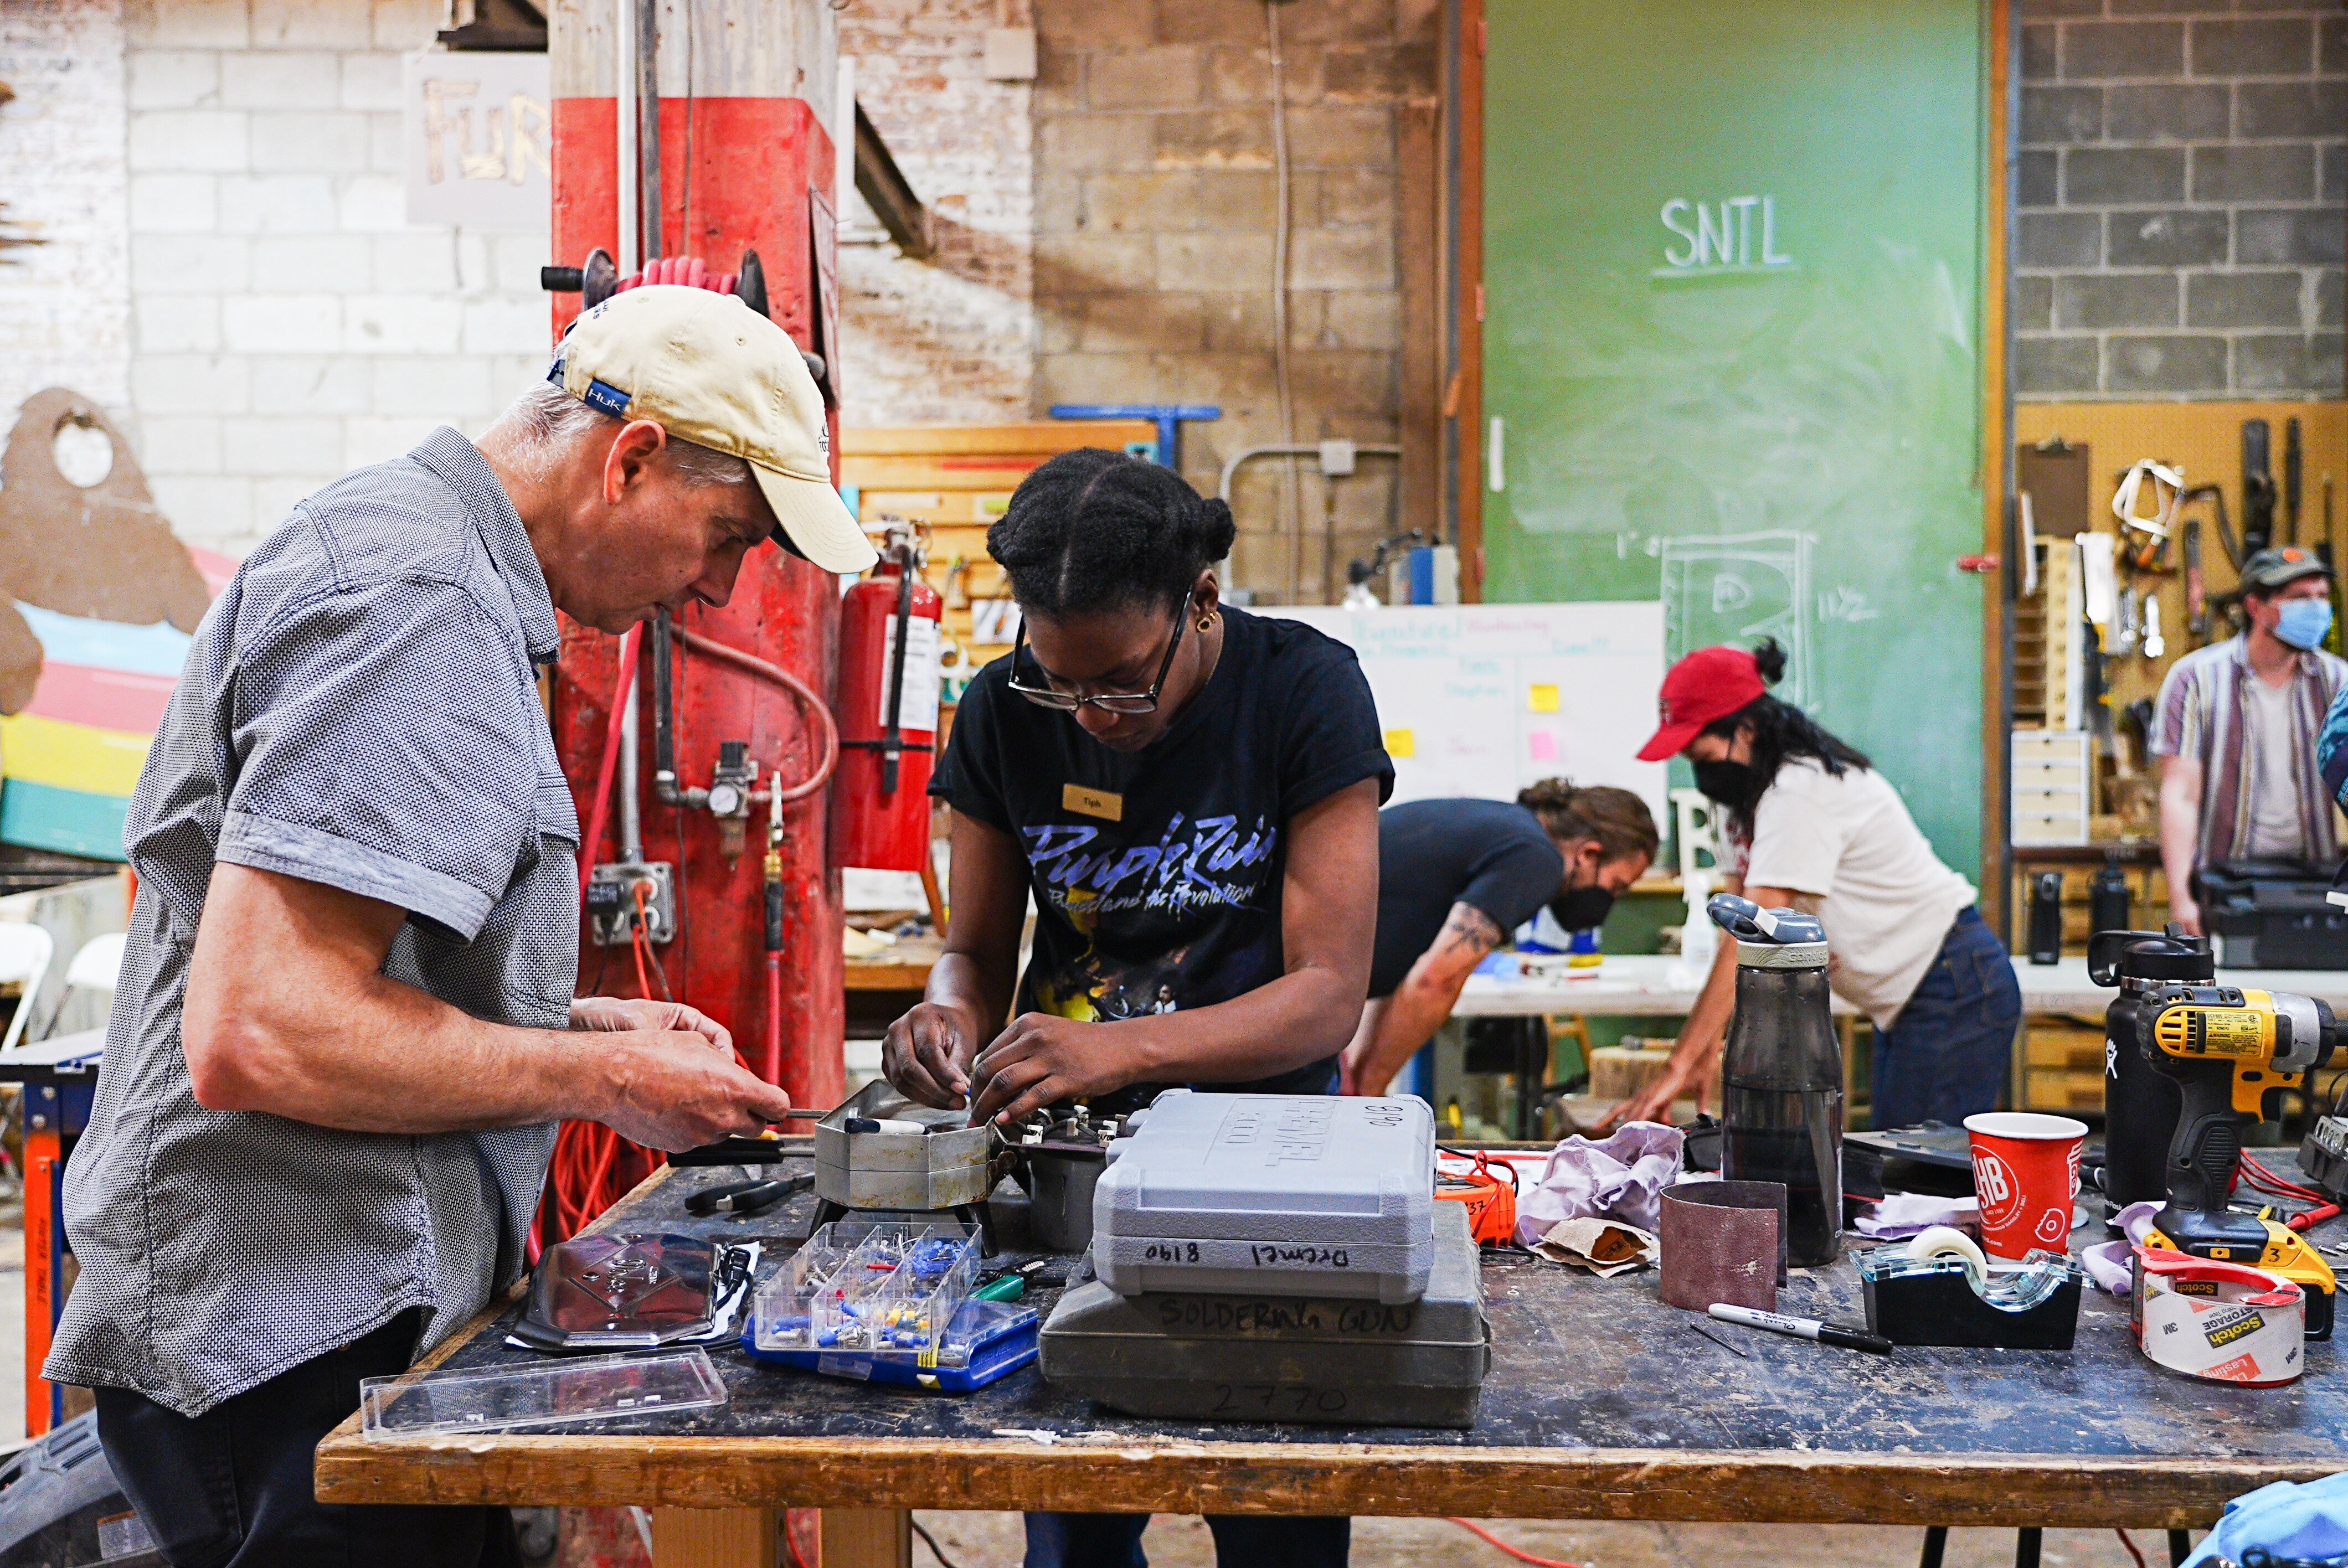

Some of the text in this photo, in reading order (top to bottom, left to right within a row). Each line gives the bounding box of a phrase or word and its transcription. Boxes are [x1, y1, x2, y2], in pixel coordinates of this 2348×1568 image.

[1661, 195, 1794, 267] SNTL
[588, 388, 621, 411] Huk
[1023, 811, 1189, 900] Purple
[1363, 1106, 1403, 1127] 8190
[1266, 1099, 1335, 1166] DREMEL
[1145, 1242, 1348, 1267] Dremel 8190
[2268, 1248, 2280, 1262] 3
[2177, 1281, 2215, 1293] Scotch
[1337, 1304, 1412, 1333] GUN
[2162, 1322, 2178, 1335] 3M
[2210, 1316, 2262, 1345] Scotch
[2202, 1358, 2248, 1379] Lasting
[1212, 1385, 1347, 1413] 2770
